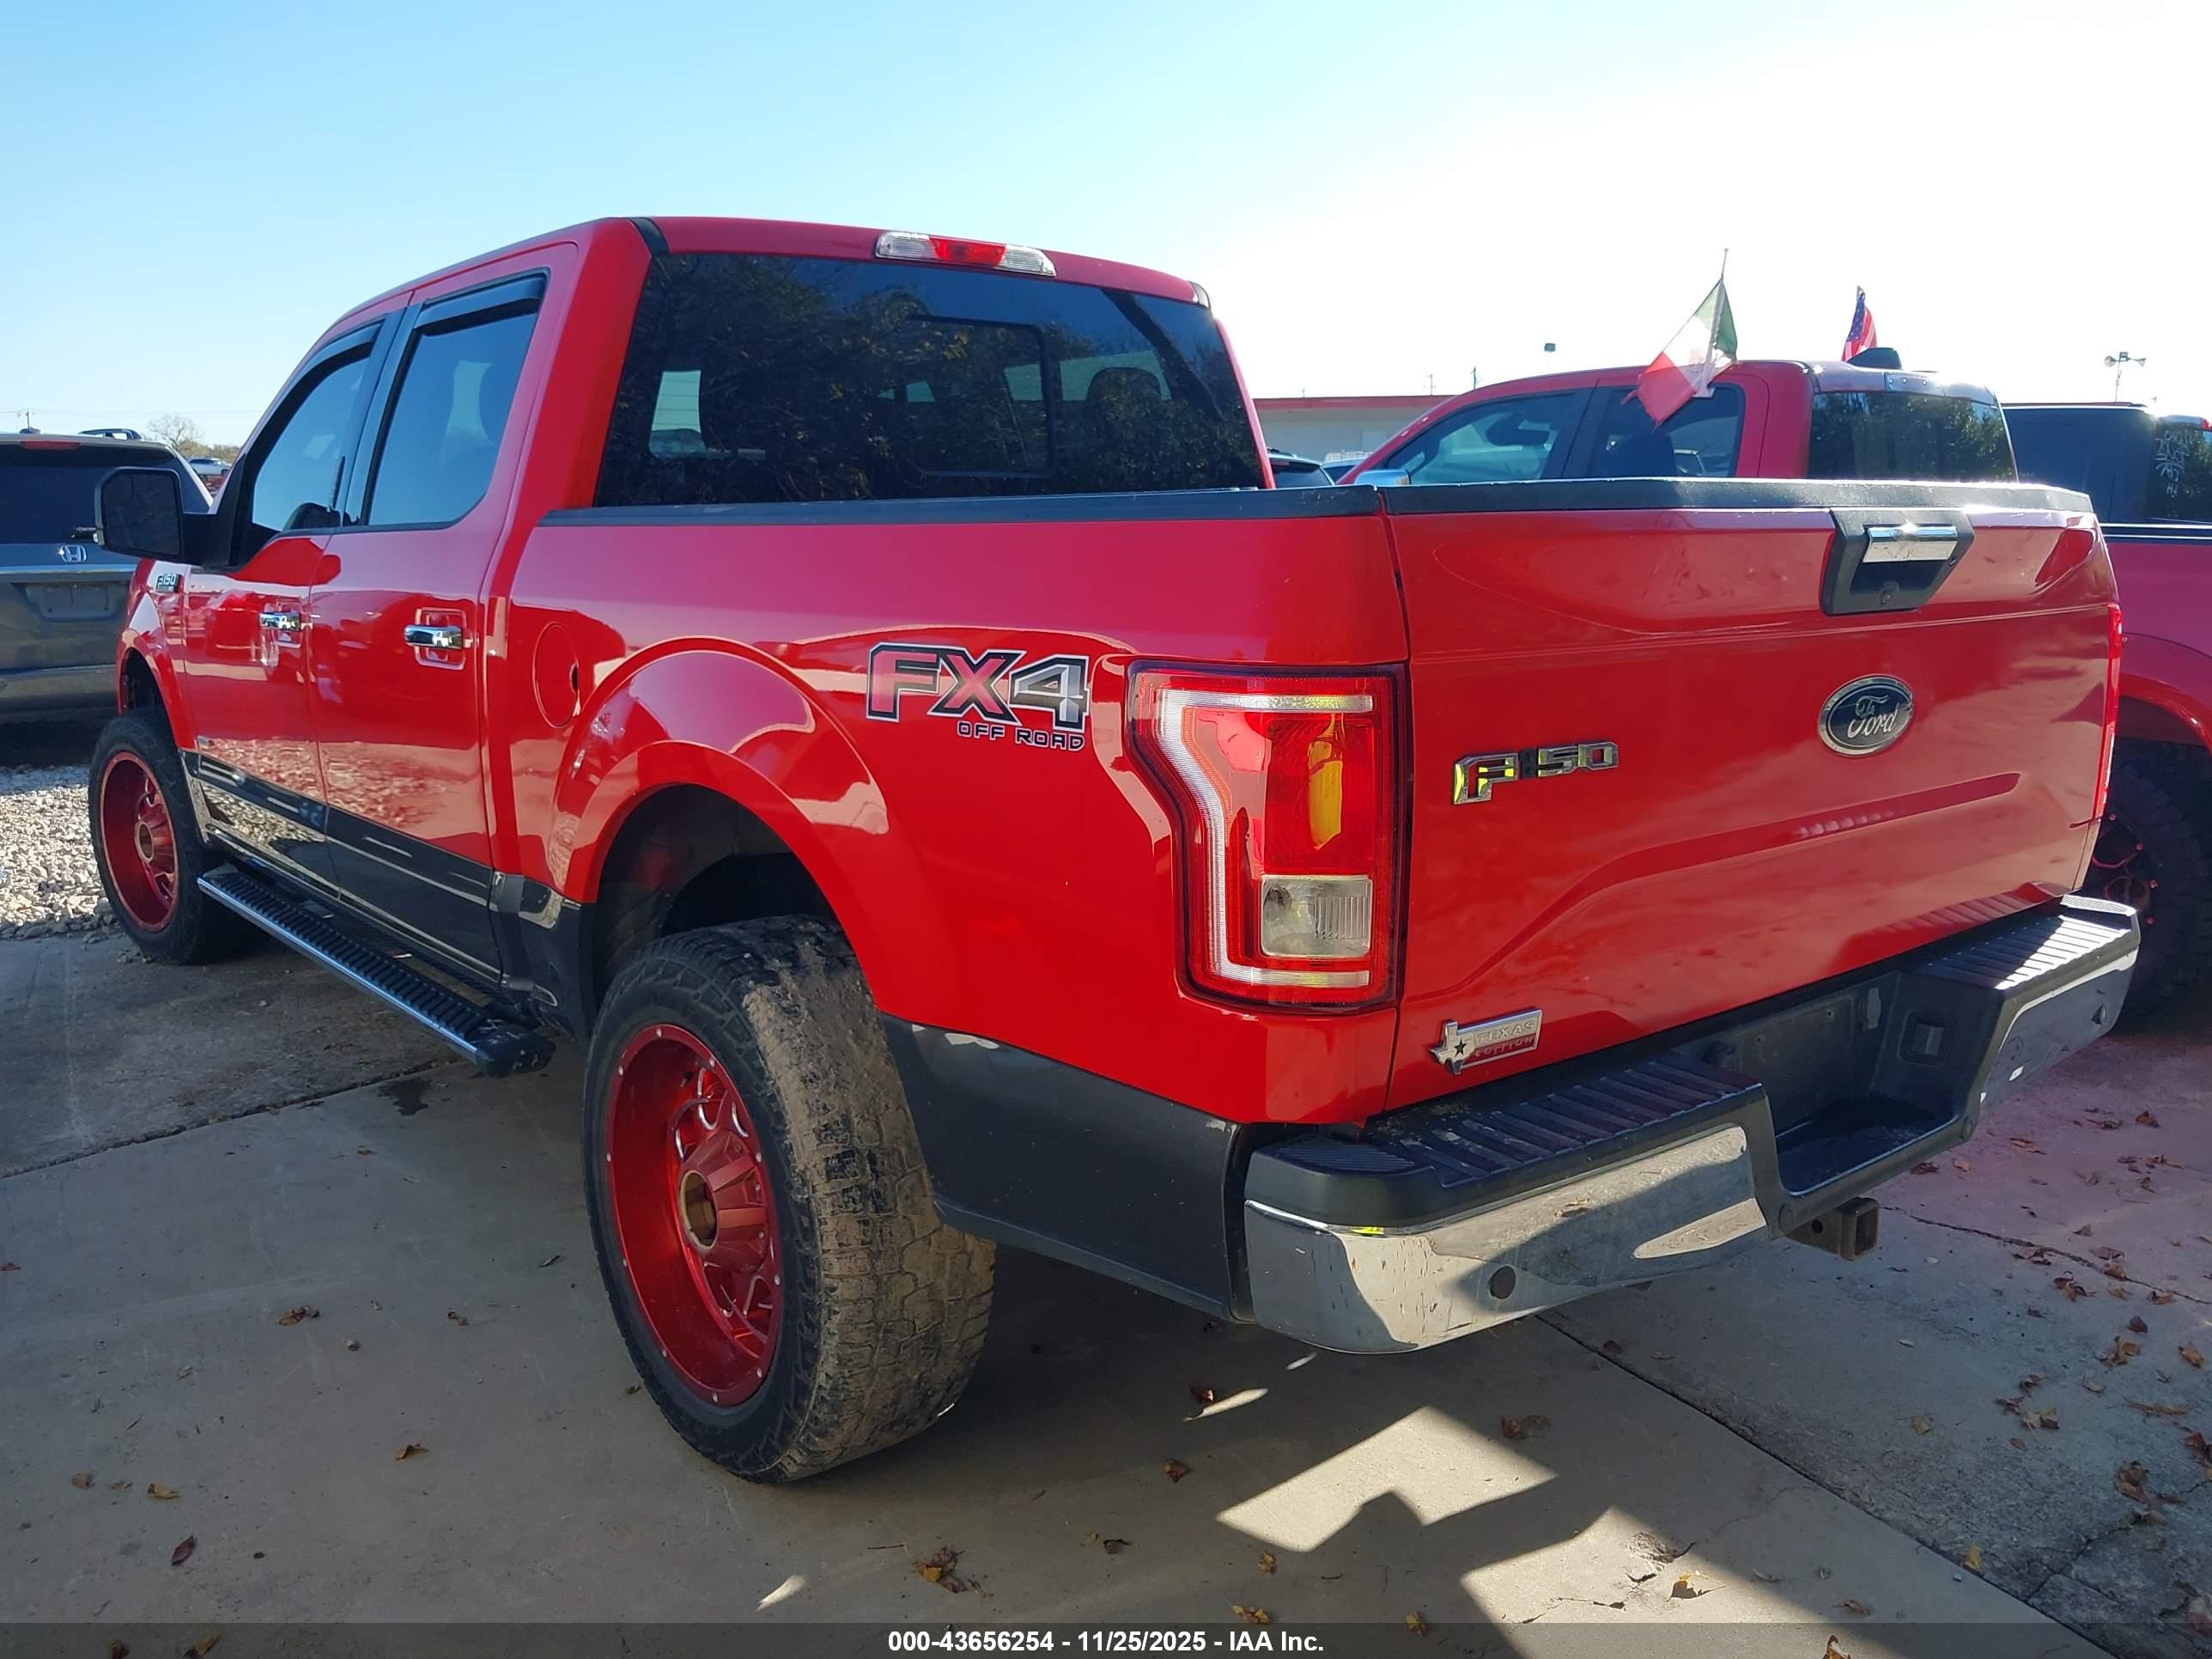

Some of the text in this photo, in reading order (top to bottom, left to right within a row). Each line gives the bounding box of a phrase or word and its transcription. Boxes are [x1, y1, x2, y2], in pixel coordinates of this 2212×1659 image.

[866, 641, 1091, 732] FX4
[1847, 694, 1900, 738] Ford
[957, 721, 1085, 751] OFF ROAD
[1475, 1019, 1536, 1044] TEXAS
